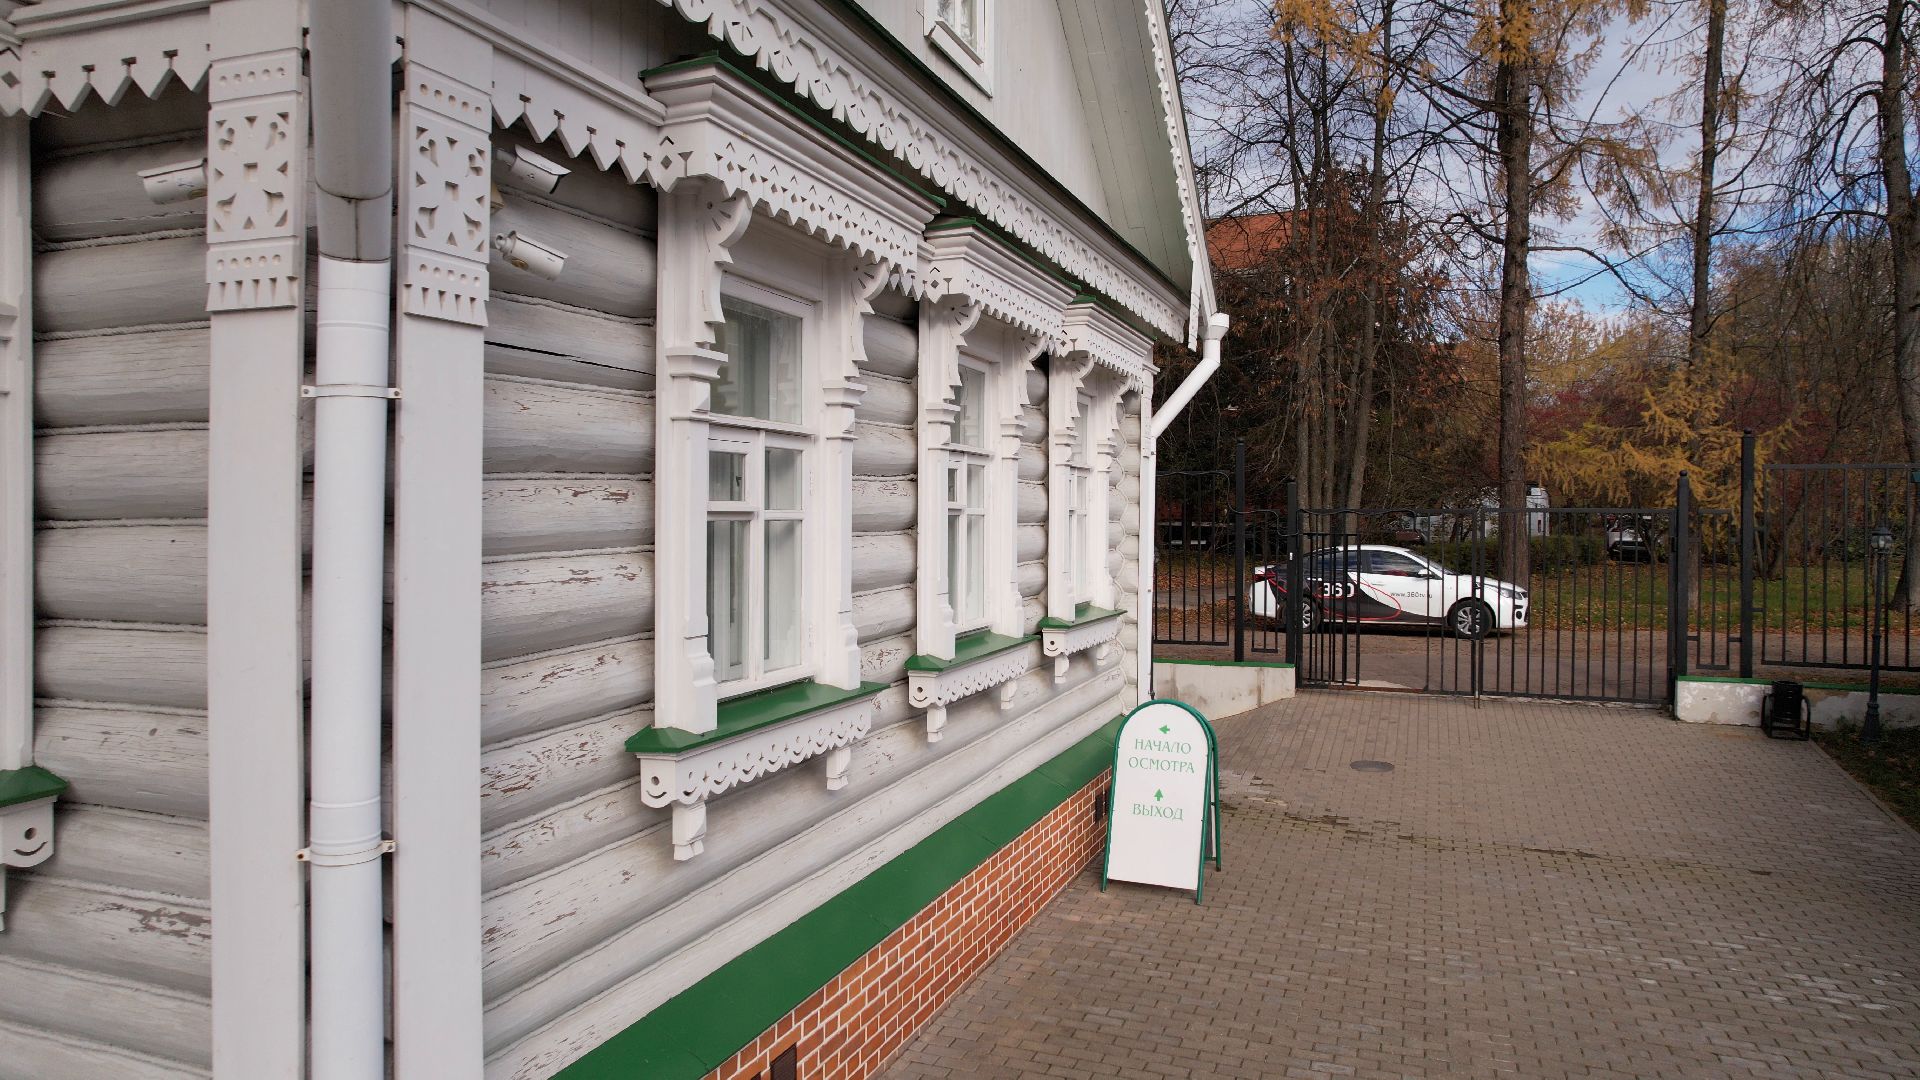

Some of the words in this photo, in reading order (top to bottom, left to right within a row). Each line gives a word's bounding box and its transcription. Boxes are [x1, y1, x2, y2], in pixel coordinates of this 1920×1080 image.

[1323, 582, 1355, 598] 360
[1134, 738, 1192, 755] НАЧАЛО
[1128, 756, 1195, 774] ОСМОТРА
[1132, 803, 1184, 822] ВЫХОД
